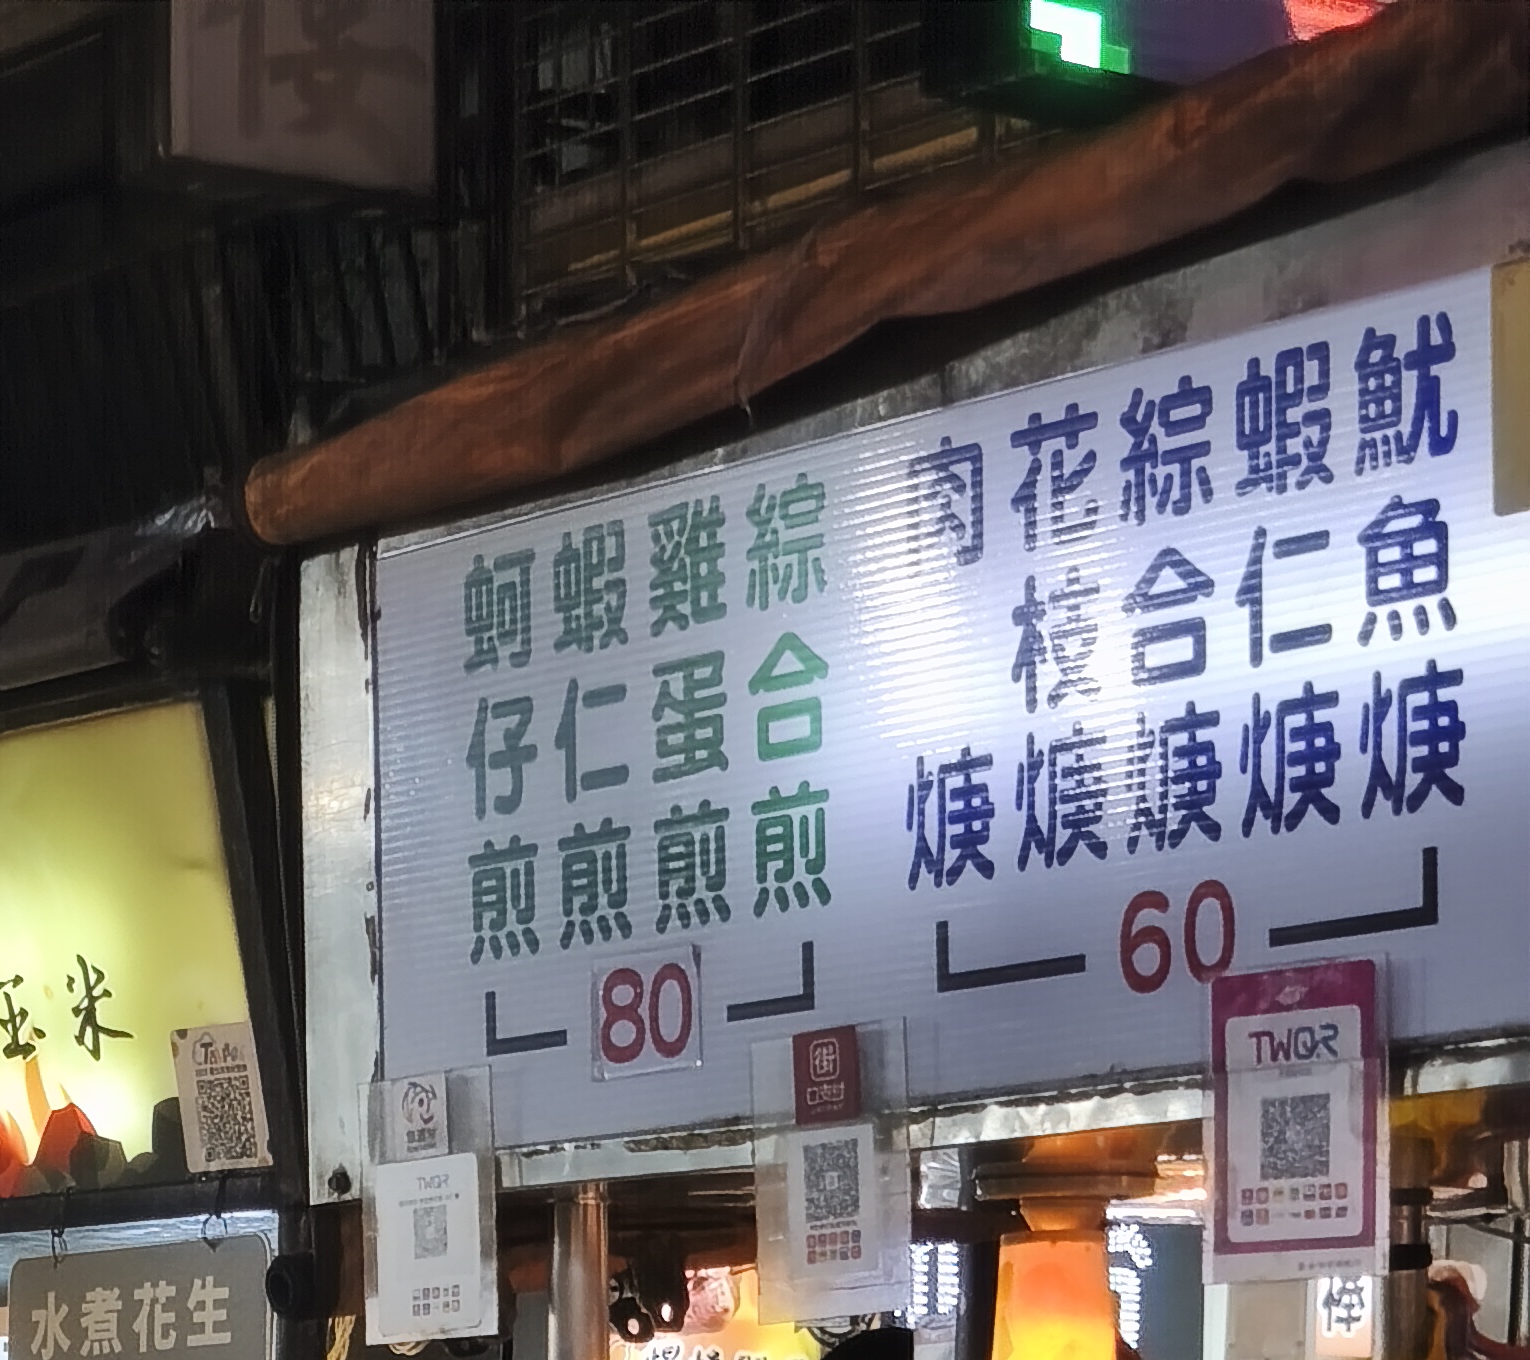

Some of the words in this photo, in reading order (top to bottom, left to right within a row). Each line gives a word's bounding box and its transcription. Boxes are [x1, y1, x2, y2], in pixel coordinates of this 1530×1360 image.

[463, 547, 539, 966] 蚵仔煎
[553, 519, 633, 949] 蝦仁煎
[648, 494, 731, 934] 雞蛋煎
[746, 472, 832, 917] 綜合煎
[1010, 402, 1108, 872] 花枝焿
[1118, 374, 1223, 854] 綜合焿
[1235, 341, 1341, 838] 蝦仁焿
[1354, 311, 1466, 821] 魷魚焿
[600, 966, 693, 1065] 80
[1119, 879, 1235, 993] 60
[1249, 1023, 1339, 1065] TWQR
[31, 1276, 232, 1360] 水煮花生
